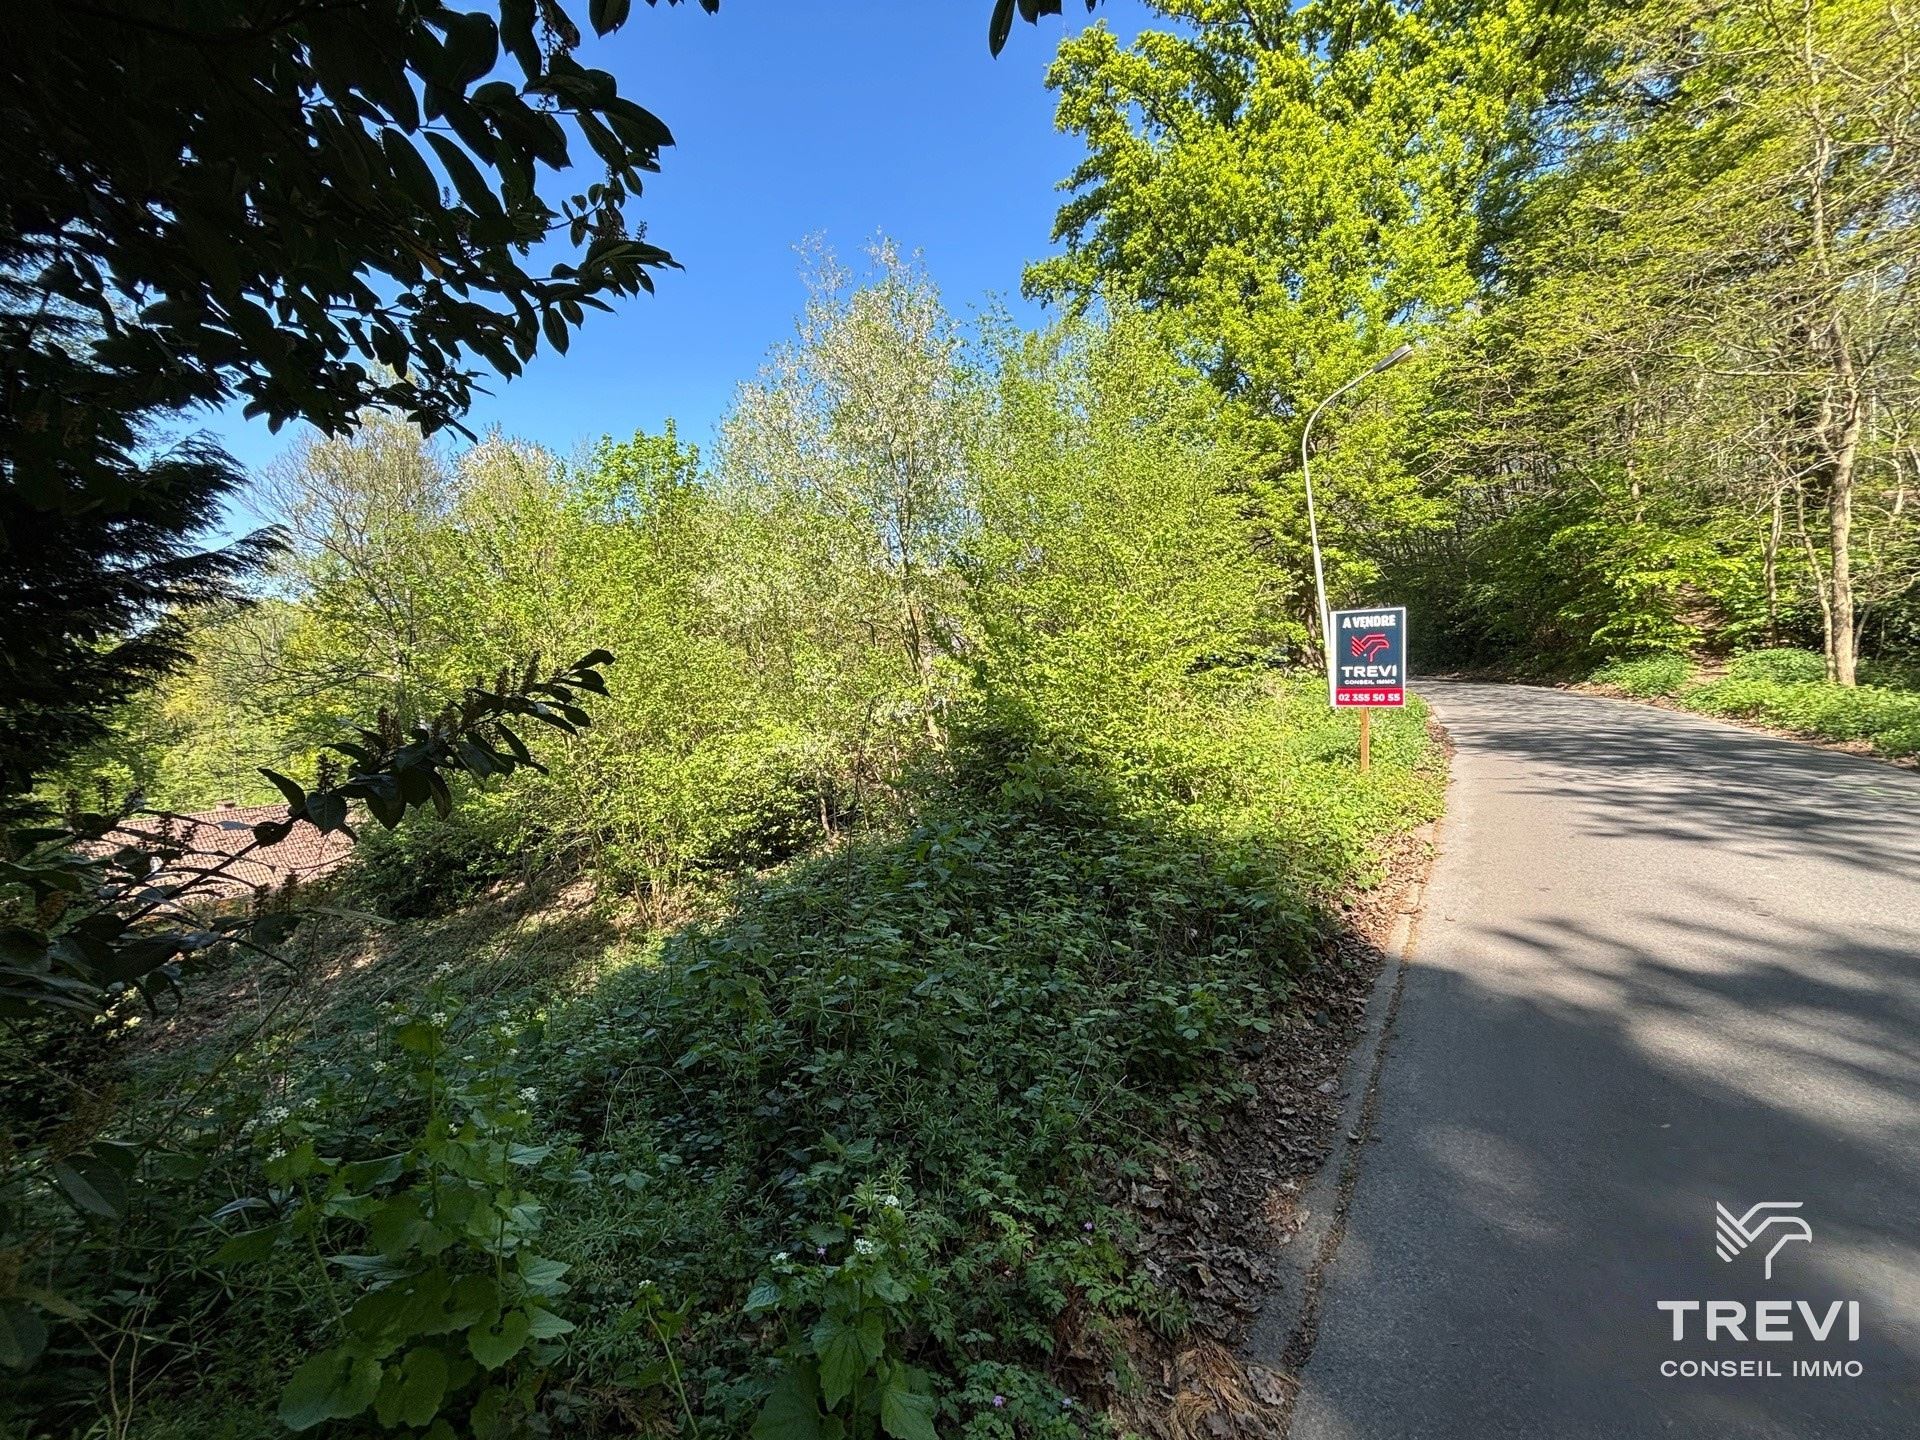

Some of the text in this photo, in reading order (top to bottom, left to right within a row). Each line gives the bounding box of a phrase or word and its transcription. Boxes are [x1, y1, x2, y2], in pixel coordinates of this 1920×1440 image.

[1342, 615, 1396, 629] A VENDRE
[1341, 664, 1397, 678] TREVI
[1338, 693, 1400, 701] 02 355 50 55
